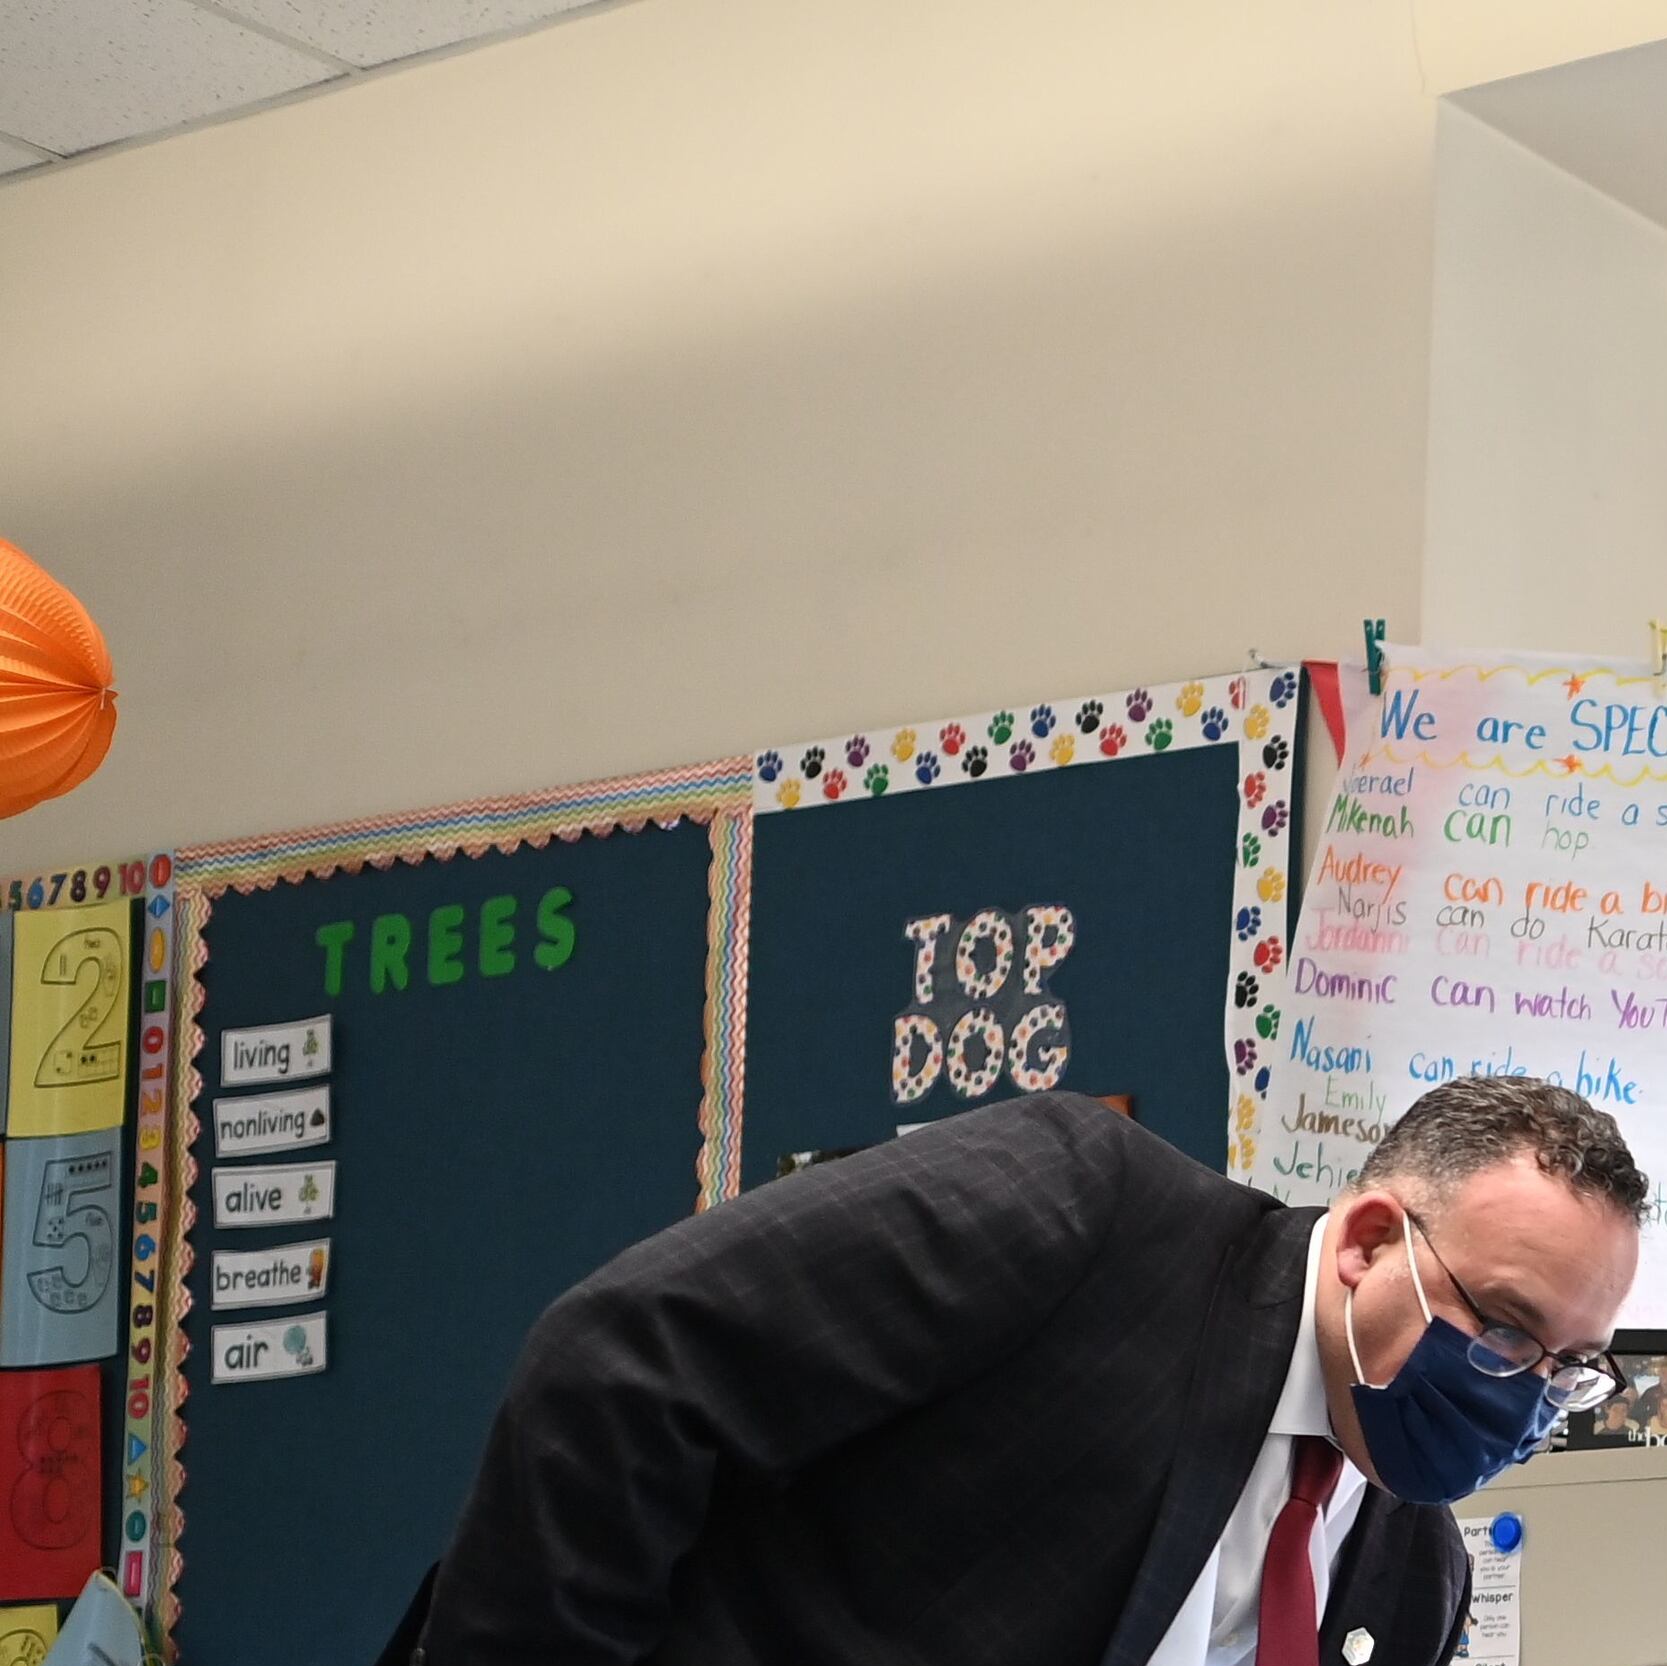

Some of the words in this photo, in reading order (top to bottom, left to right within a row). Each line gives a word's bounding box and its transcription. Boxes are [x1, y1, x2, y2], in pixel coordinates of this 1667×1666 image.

[1381, 689, 1438, 741] We
[1478, 718, 1546, 750] are
[1327, 793, 1414, 838] Mikenah
[1444, 809, 1512, 847] can
[1542, 816, 1589, 860] hop
[1459, 783, 1511, 811] can
[1545, 784, 1600, 818] ride
[1622, 802, 1639, 825] a
[1317, 845, 1402, 905] Audrey
[1443, 873, 1503, 905] can
[1524, 880, 1587, 912] ride
[1601, 888, 1623, 914] a
[315, 886, 577, 996] TREES
[1338, 886, 1407, 933] Narjis
[1436, 904, 1485, 928] can
[1510, 906, 1544, 941] do
[905, 905, 1075, 1003] TOP
[34, 927, 123, 1088] 2
[1295, 958, 1396, 1003] Dominic
[1431, 975, 1496, 1013] can
[1515, 986, 1591, 1019] watch
[232, 1037, 291, 1074] living
[893, 1004, 1067, 1102] DOG
[1289, 1017, 1372, 1075] Nasani
[1408, 1052, 1454, 1079] can
[220, 1106, 306, 1142] nonliving
[1323, 1076, 1387, 1126] Emily
[225, 1182, 282, 1213] alive
[27, 1150, 113, 1315] 5
[215, 1259, 302, 1290] breathe
[224, 1337, 269, 1370] air
